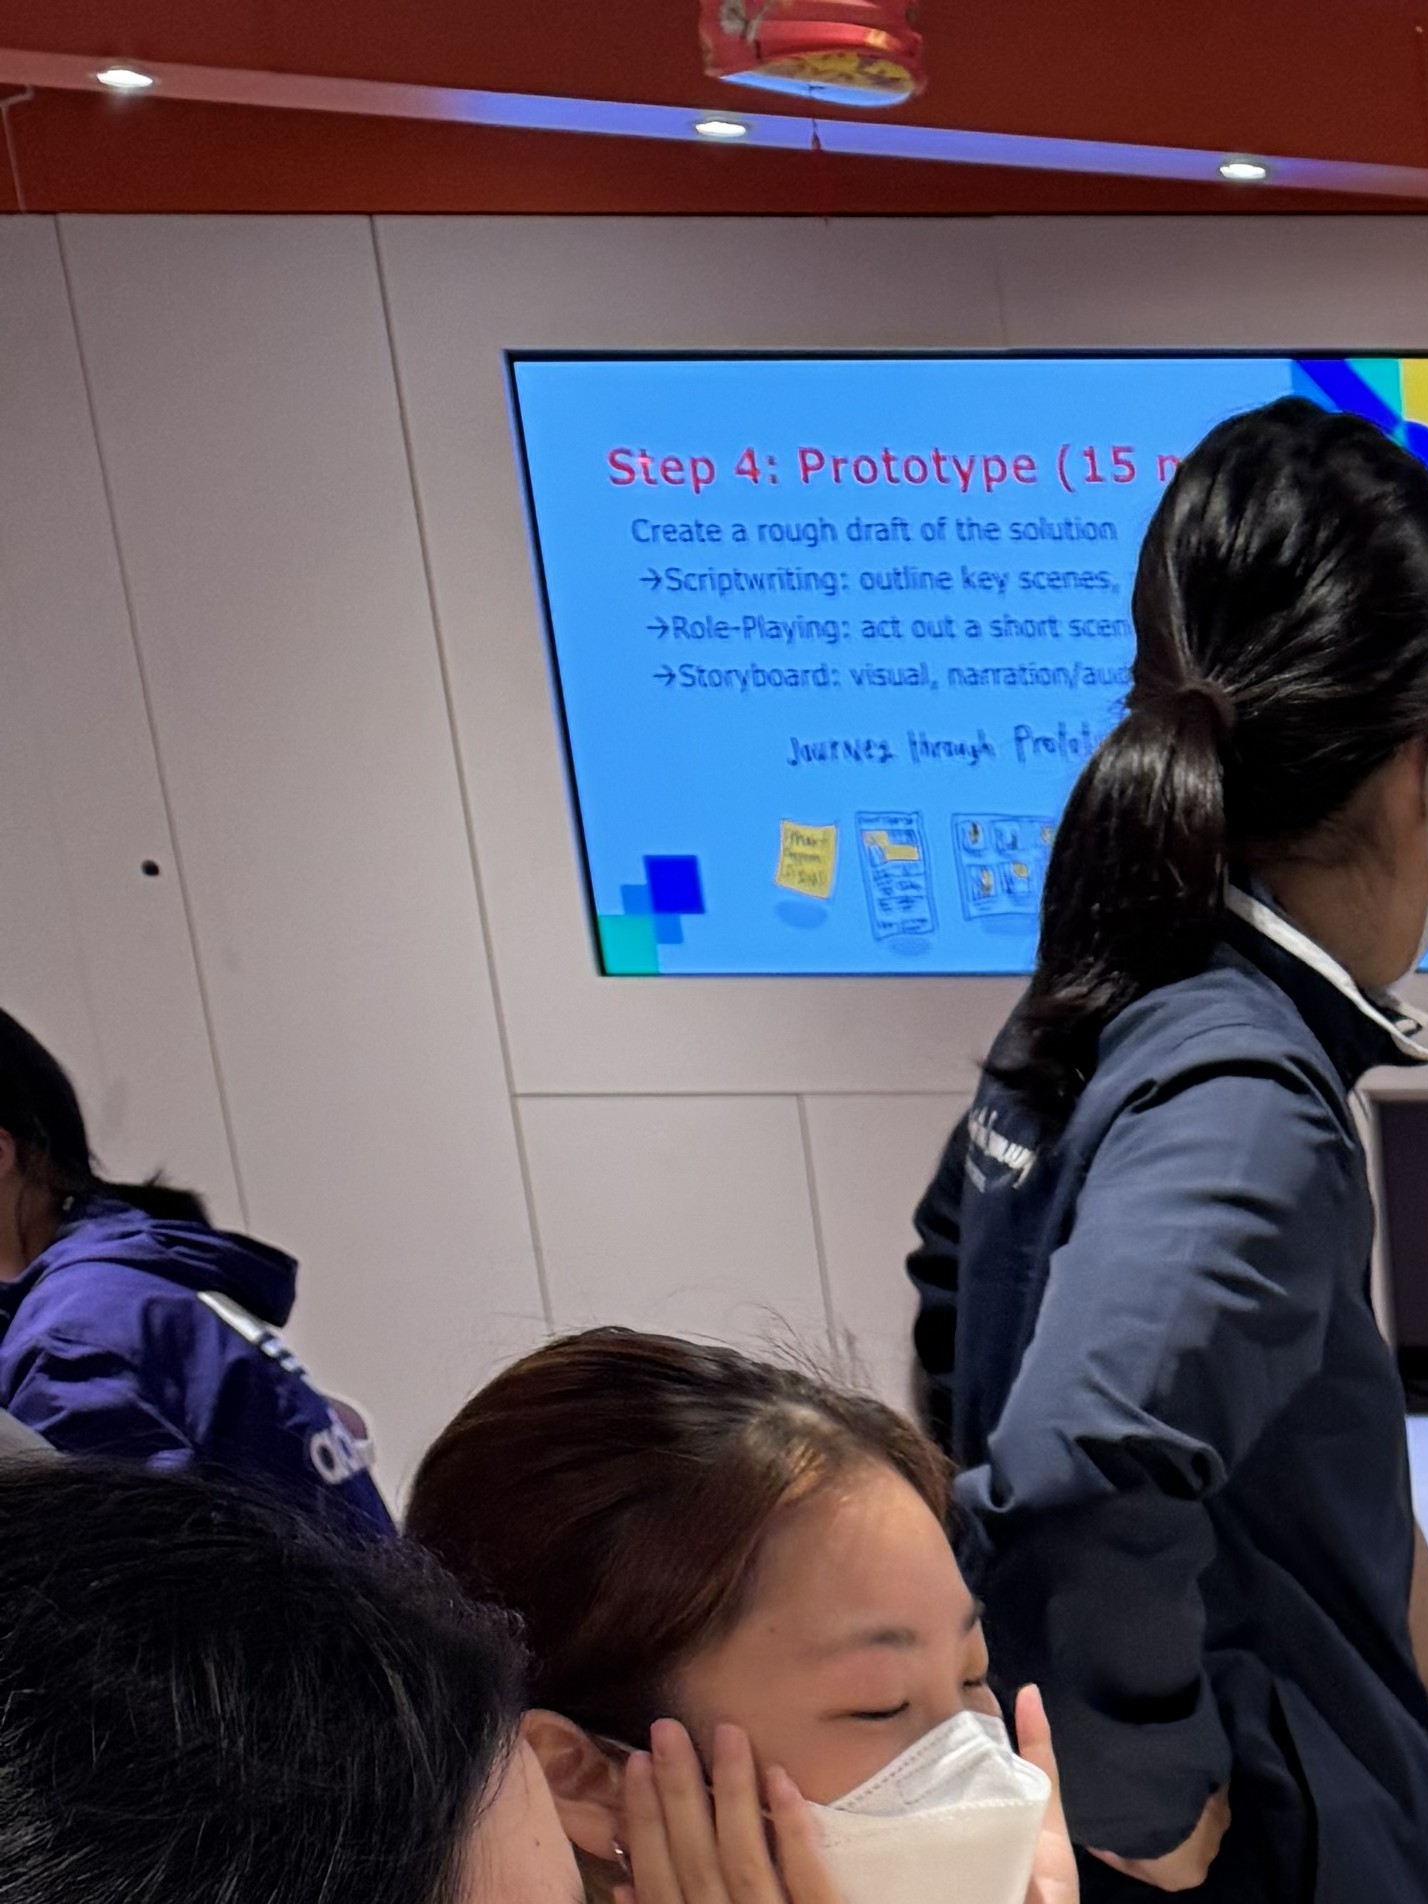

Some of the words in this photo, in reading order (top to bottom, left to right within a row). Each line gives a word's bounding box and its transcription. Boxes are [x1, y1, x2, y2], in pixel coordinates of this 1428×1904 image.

[607, 446, 715, 494] Step
[735, 446, 777, 485] 4:
[798, 445, 1037, 494] Prototype
[1058, 443, 1136, 493] (15
[631, 518, 722, 542] Create
[731, 523, 748, 542] a
[757, 517, 838, 547] rough
[846, 516, 911, 542] draft
[919, 516, 947, 542] of
[956, 516, 1000, 541] the
[1008, 516, 1118, 542] solution
[664, 566, 850, 596] Scriptwriting:
[859, 565, 953, 591] outline
[960, 565, 1009, 596] key
[1017, 568, 1121, 594] scenes,
[671, 614, 850, 644] Role-Playing:
[860, 616, 902, 639] act
[910, 615, 956, 639] out
[964, 619, 982, 638] a
[989, 613, 1061, 639] short
[678, 662, 840, 692] Storyboard:
[850, 661, 939, 691] visual,
